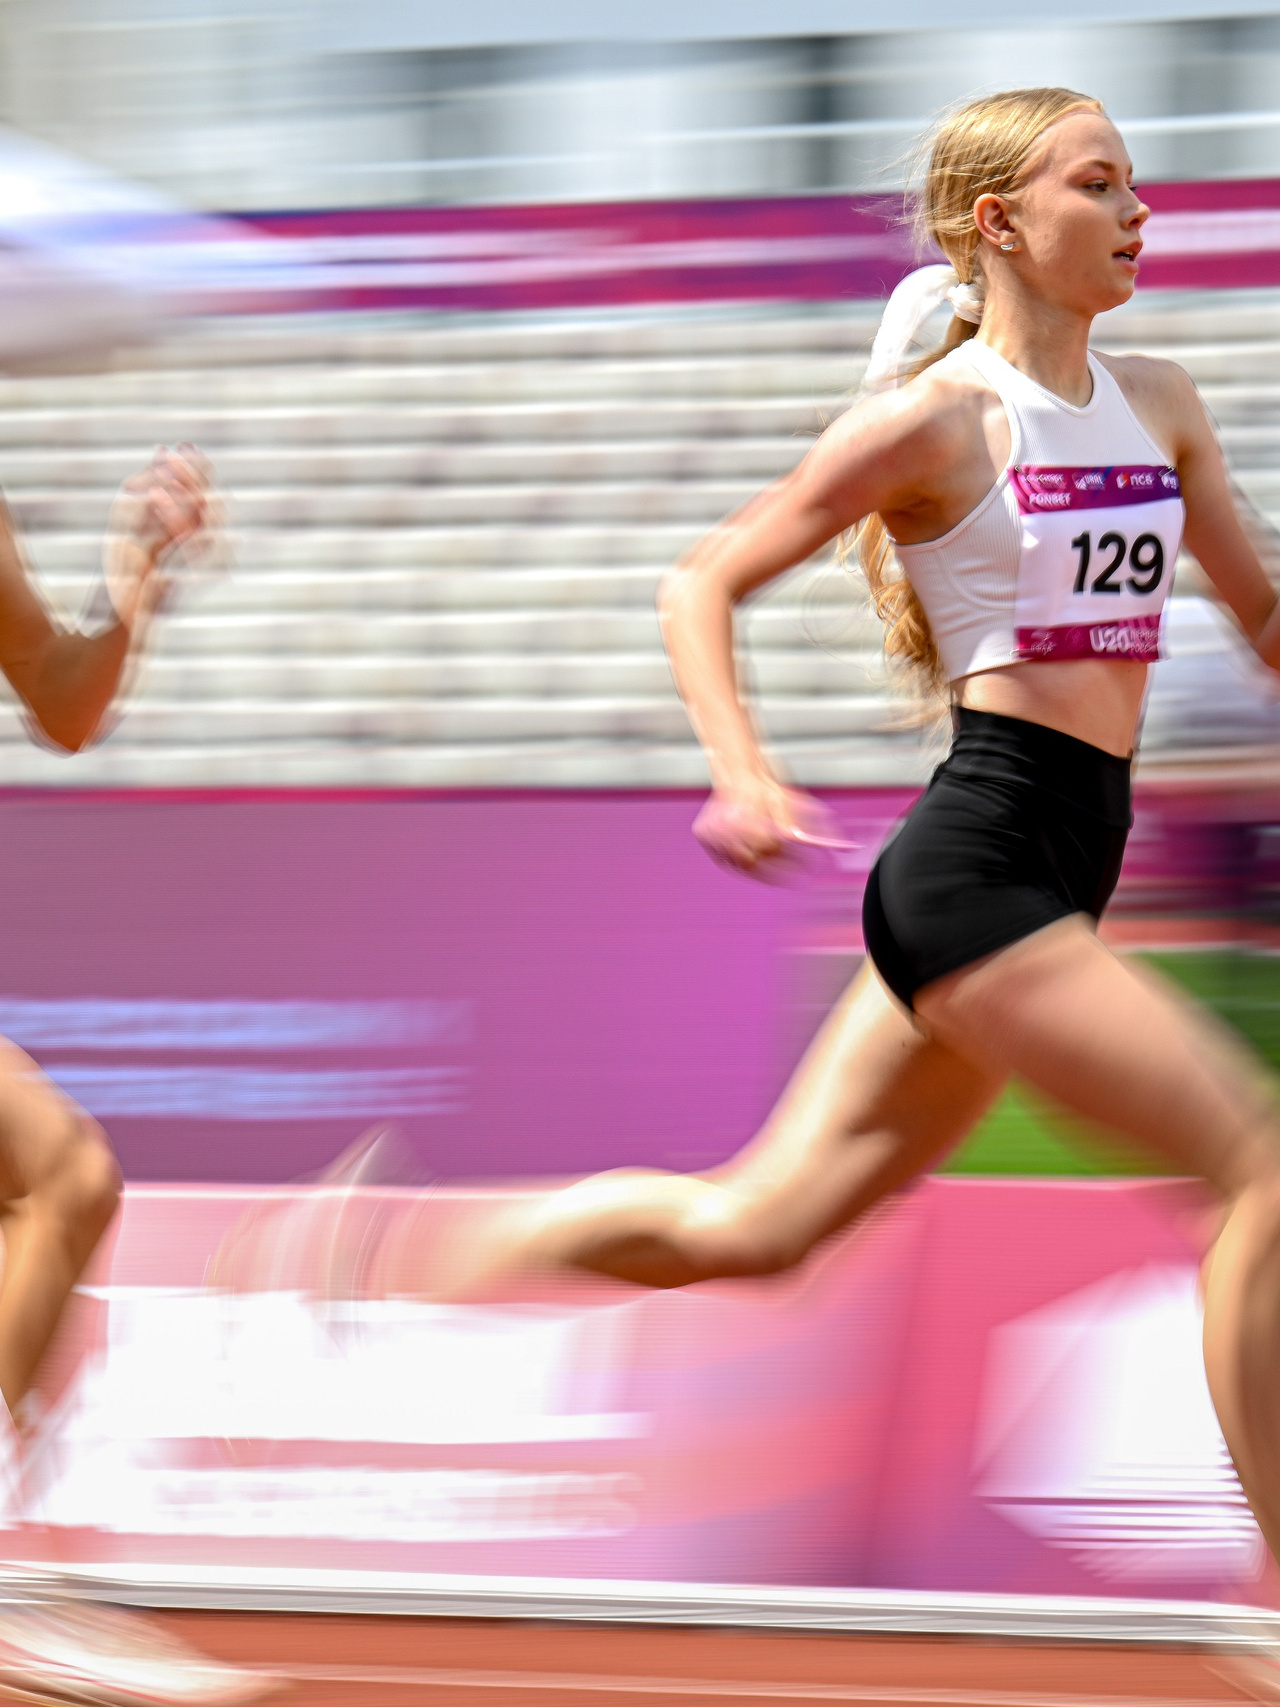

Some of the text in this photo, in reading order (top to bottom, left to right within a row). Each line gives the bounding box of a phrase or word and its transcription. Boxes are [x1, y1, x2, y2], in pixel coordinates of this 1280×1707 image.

[1029, 492, 1072, 507] FONBET
[1072, 530, 1165, 596] 129
[1089, 625, 1131, 653] U20
